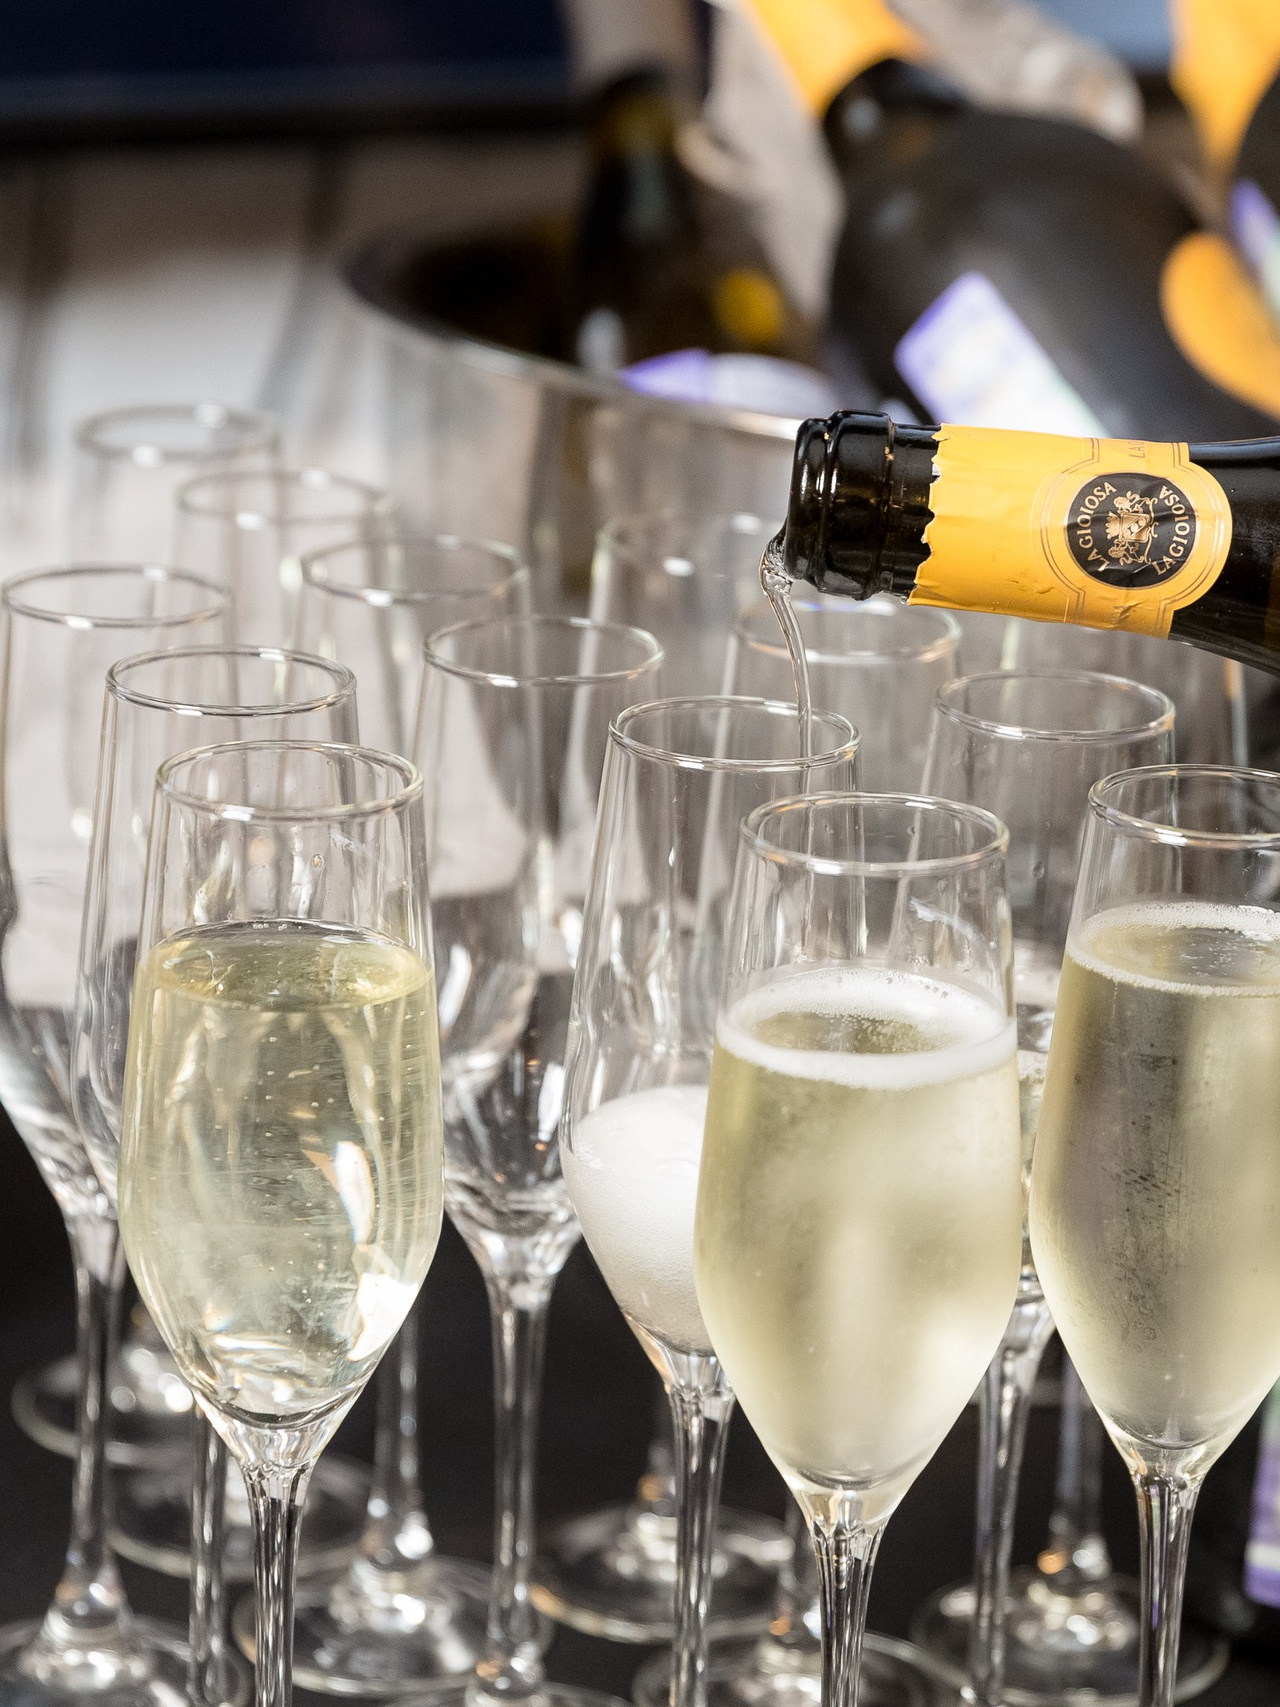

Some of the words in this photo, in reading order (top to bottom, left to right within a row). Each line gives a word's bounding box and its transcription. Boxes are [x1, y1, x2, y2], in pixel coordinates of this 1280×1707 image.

[1076, 481, 1117, 549] GIOIOSA
[1159, 485, 1190, 558] GIOIOSA
[1087, 547, 1110, 572] LA
[1152, 556, 1177, 576] LA
